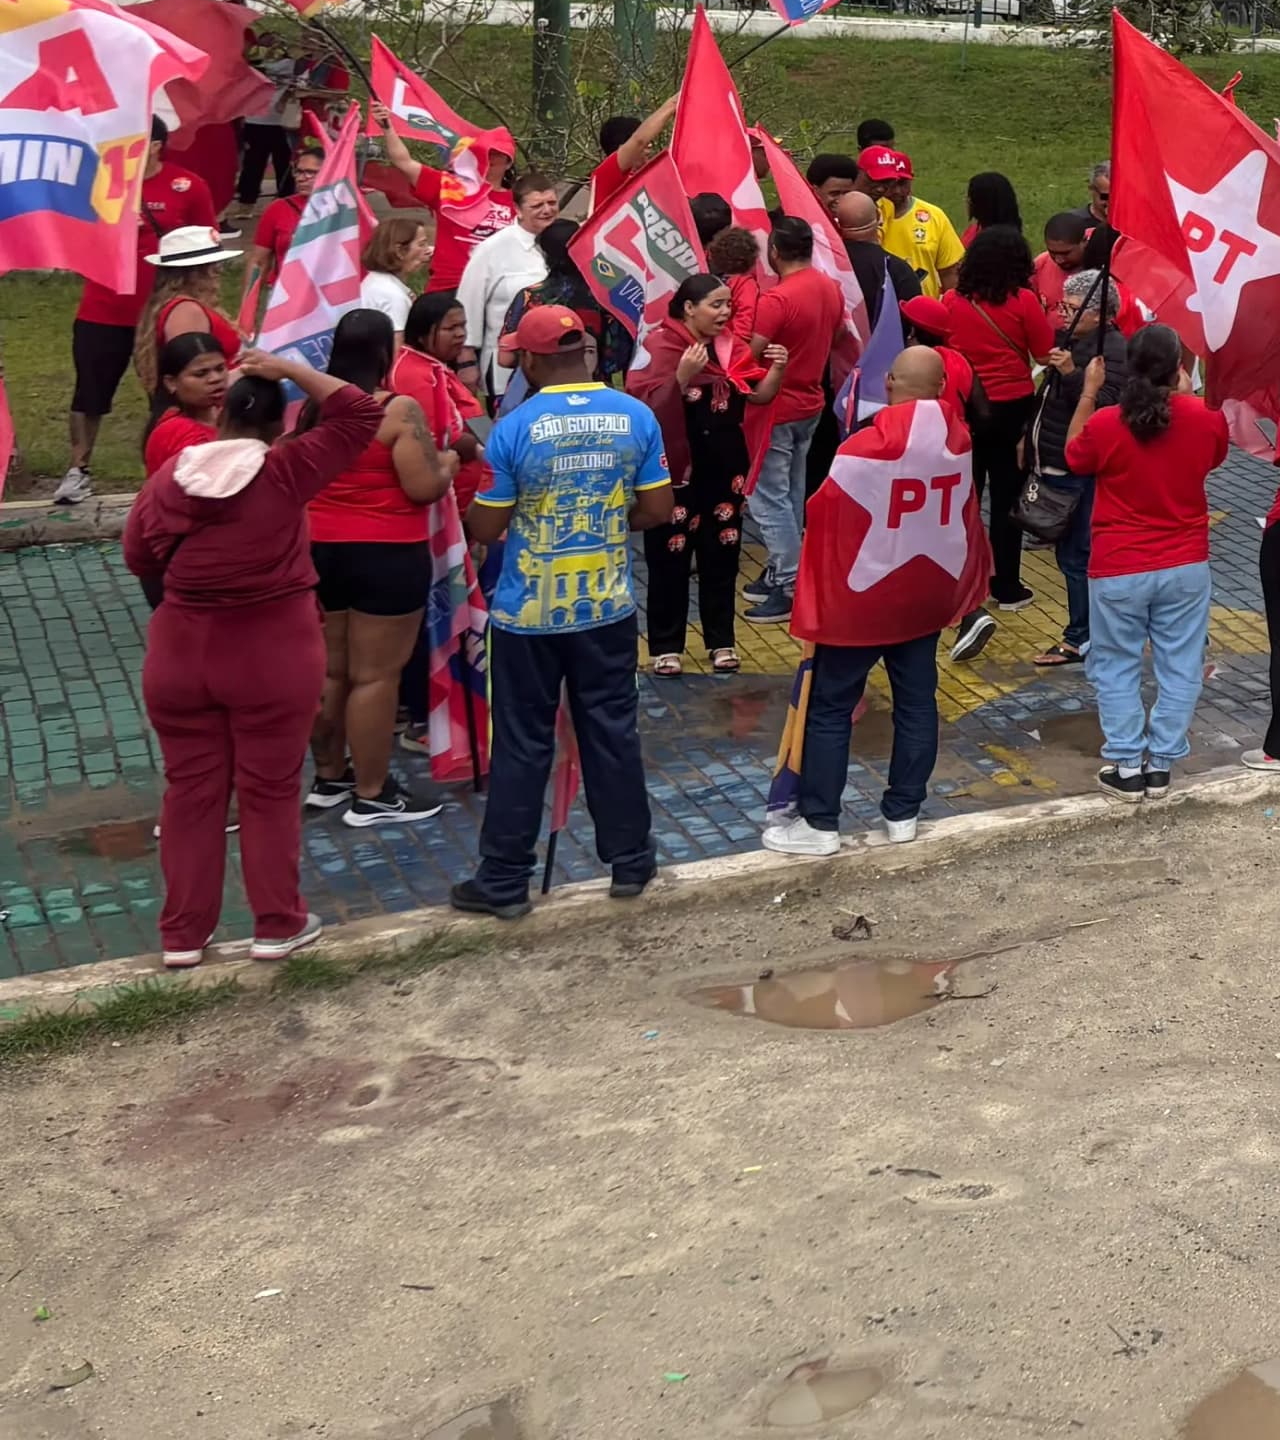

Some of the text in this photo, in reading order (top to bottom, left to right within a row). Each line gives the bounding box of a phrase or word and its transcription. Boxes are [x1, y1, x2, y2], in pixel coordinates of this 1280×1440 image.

[1181, 210, 1258, 285] PT
[531, 414, 563, 443] SÃO
[888, 471, 962, 530] PT
